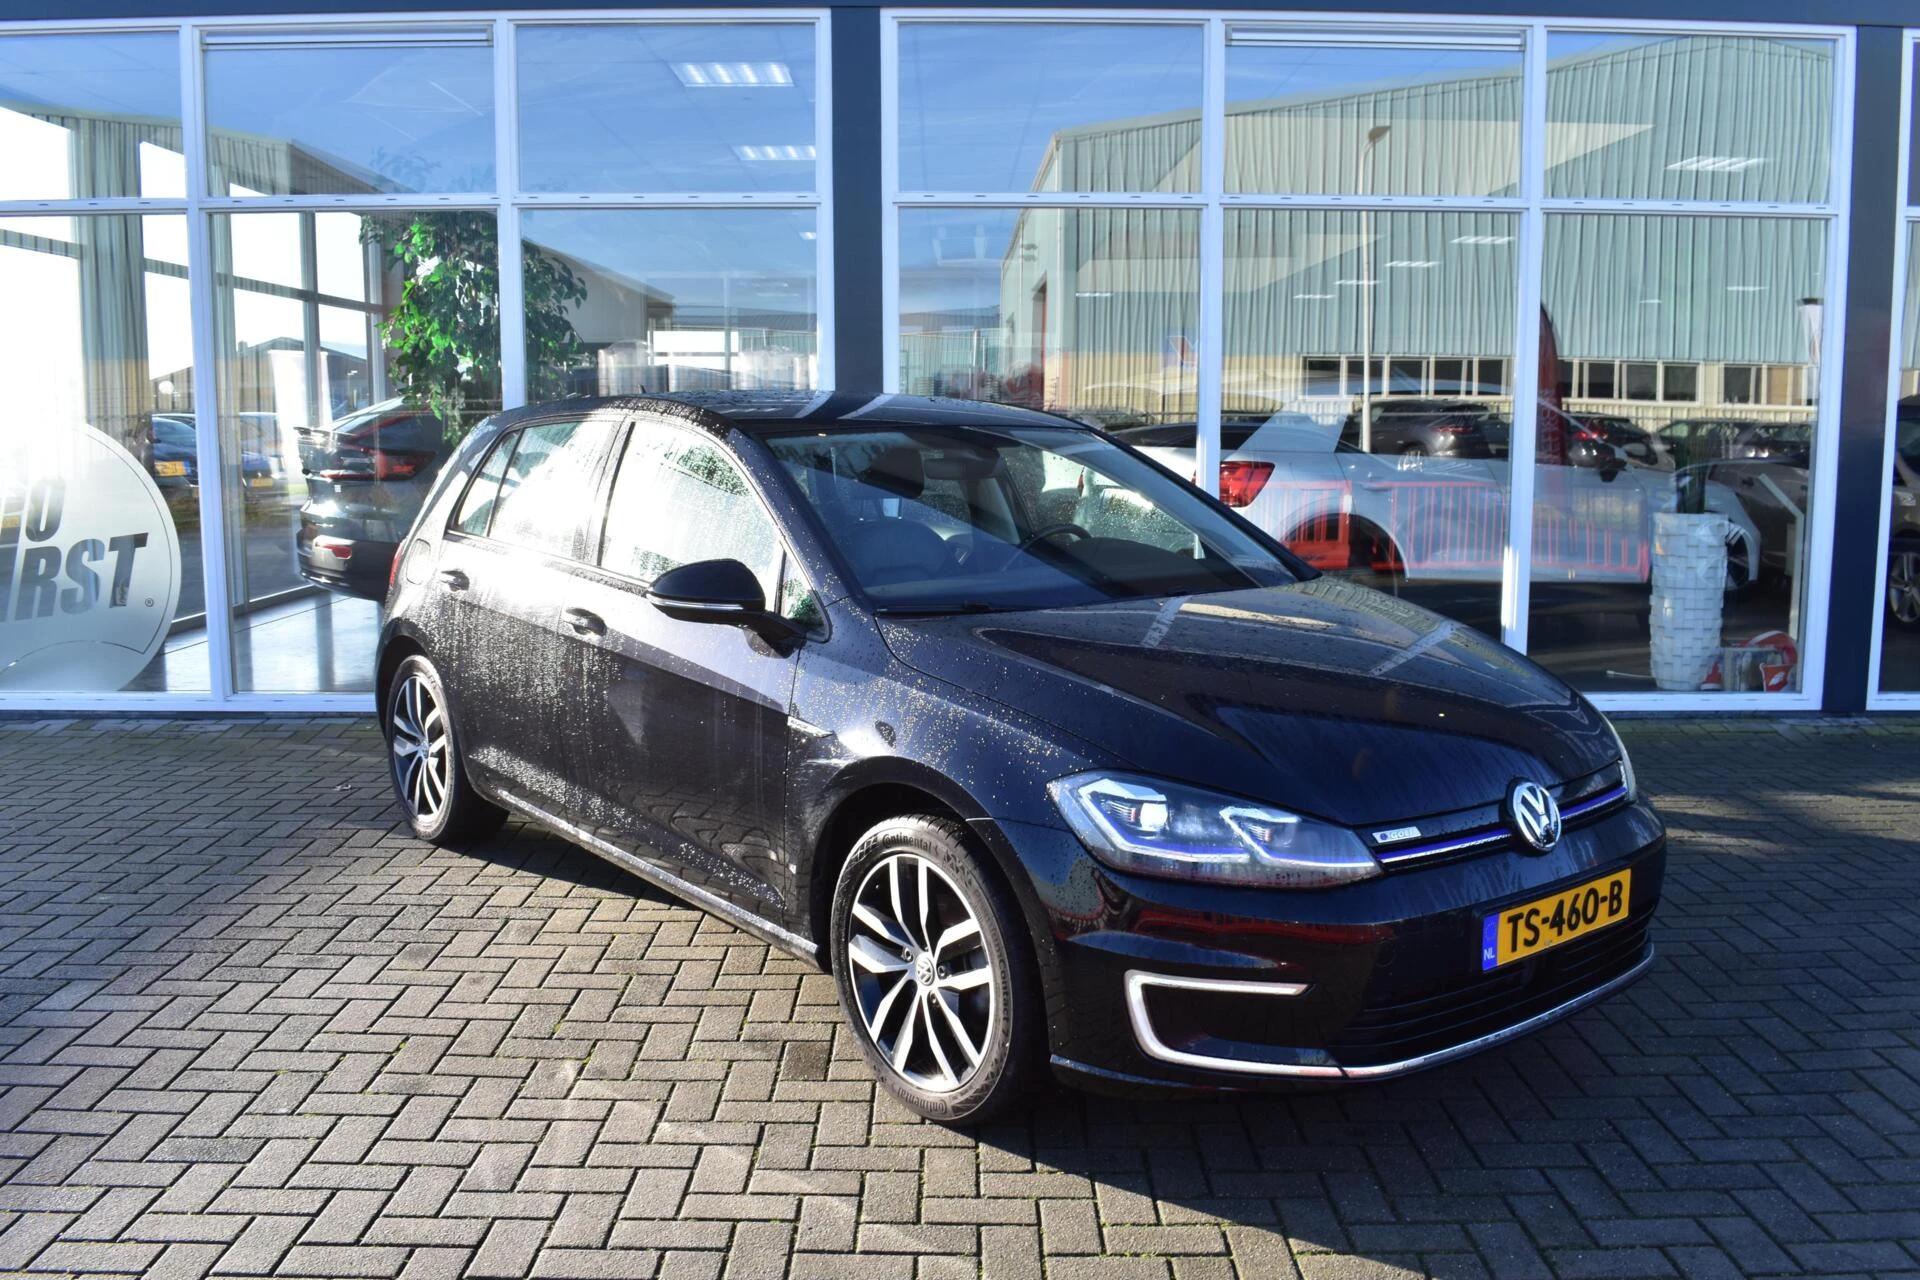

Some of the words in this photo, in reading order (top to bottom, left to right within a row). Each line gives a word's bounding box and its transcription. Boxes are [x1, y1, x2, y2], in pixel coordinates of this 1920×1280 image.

[882, 832, 932, 853] Continental
[1507, 879, 1623, 953] TS-460-B
[1483, 947, 1496, 961] NL
